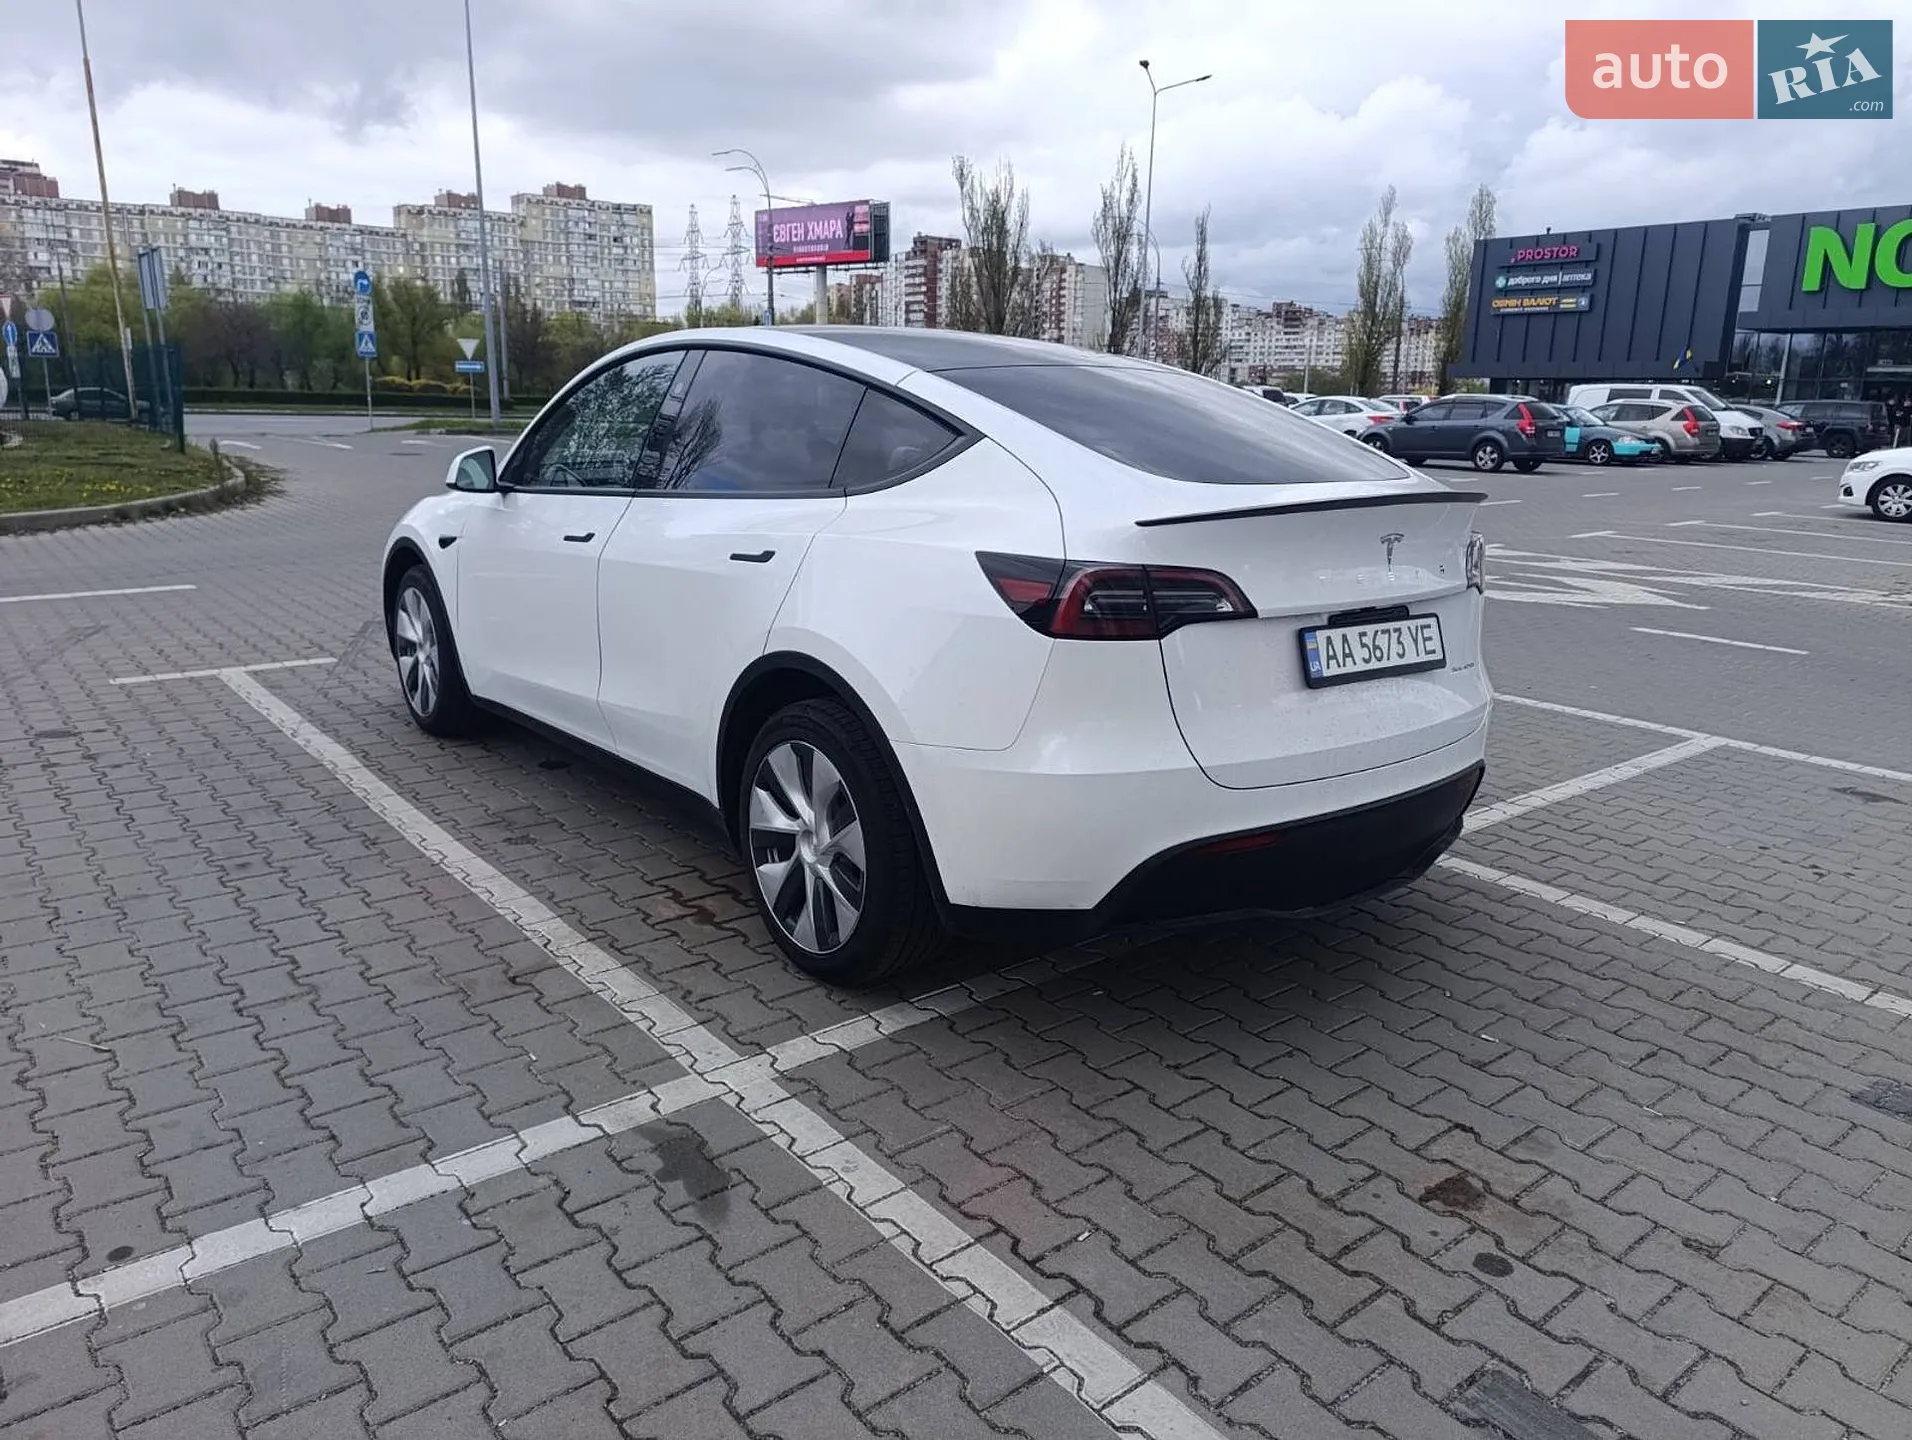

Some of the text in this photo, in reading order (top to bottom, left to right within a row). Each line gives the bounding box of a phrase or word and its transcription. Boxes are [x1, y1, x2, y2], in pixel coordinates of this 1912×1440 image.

[773, 222, 805, 243] ЄВГЕН
[807, 219, 843, 240] ХМАРА
[1325, 623, 1437, 670] AA 5673 YE
